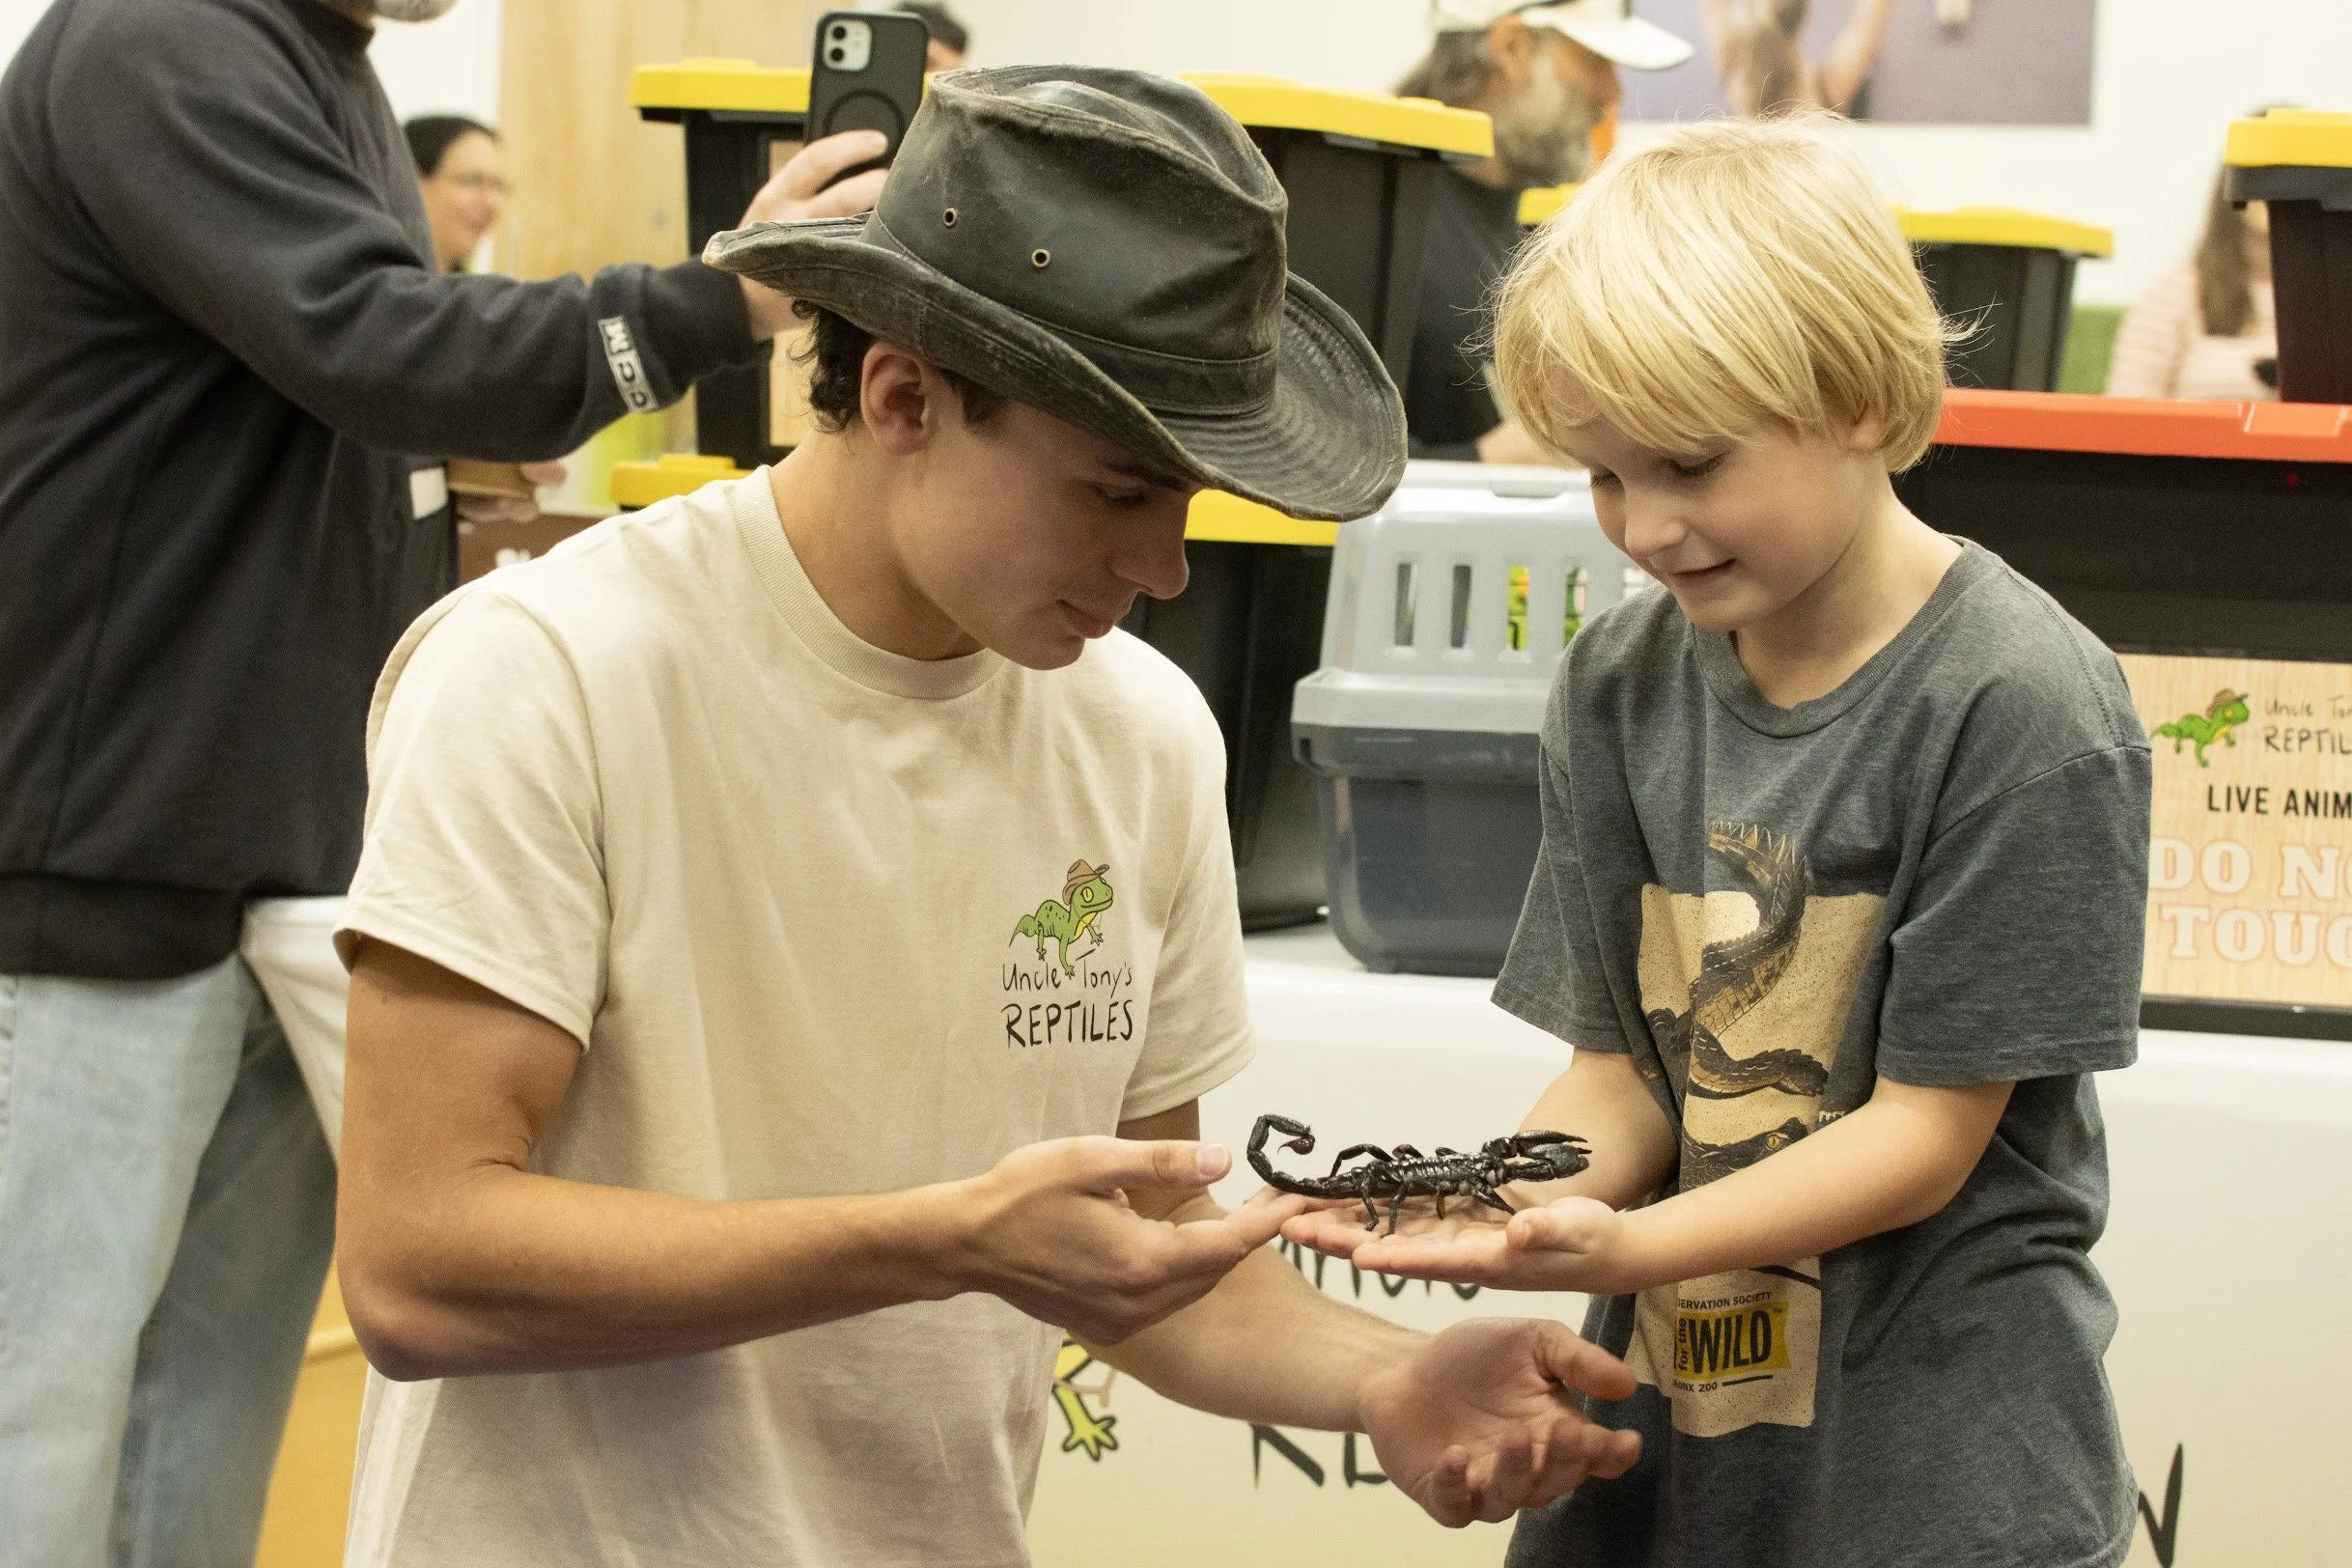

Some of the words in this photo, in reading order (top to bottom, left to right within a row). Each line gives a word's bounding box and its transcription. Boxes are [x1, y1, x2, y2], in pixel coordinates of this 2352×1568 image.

[2264, 698, 2313, 716] Uncle
[2208, 784, 2268, 815] LIVE
[2149, 837, 2252, 894] DO
[2278, 843, 2352, 901] N
[1001, 963, 1061, 992] Uncle
[1075, 948, 1133, 999] Tony's
[1000, 999, 1133, 1050] REPTILES
[1732, 1291, 1771, 1306] SOCIETY
[1689, 1310, 1772, 1373] WILD
[1678, 1349, 1688, 1370] for
[1698, 1382, 1718, 1392] ZOO
